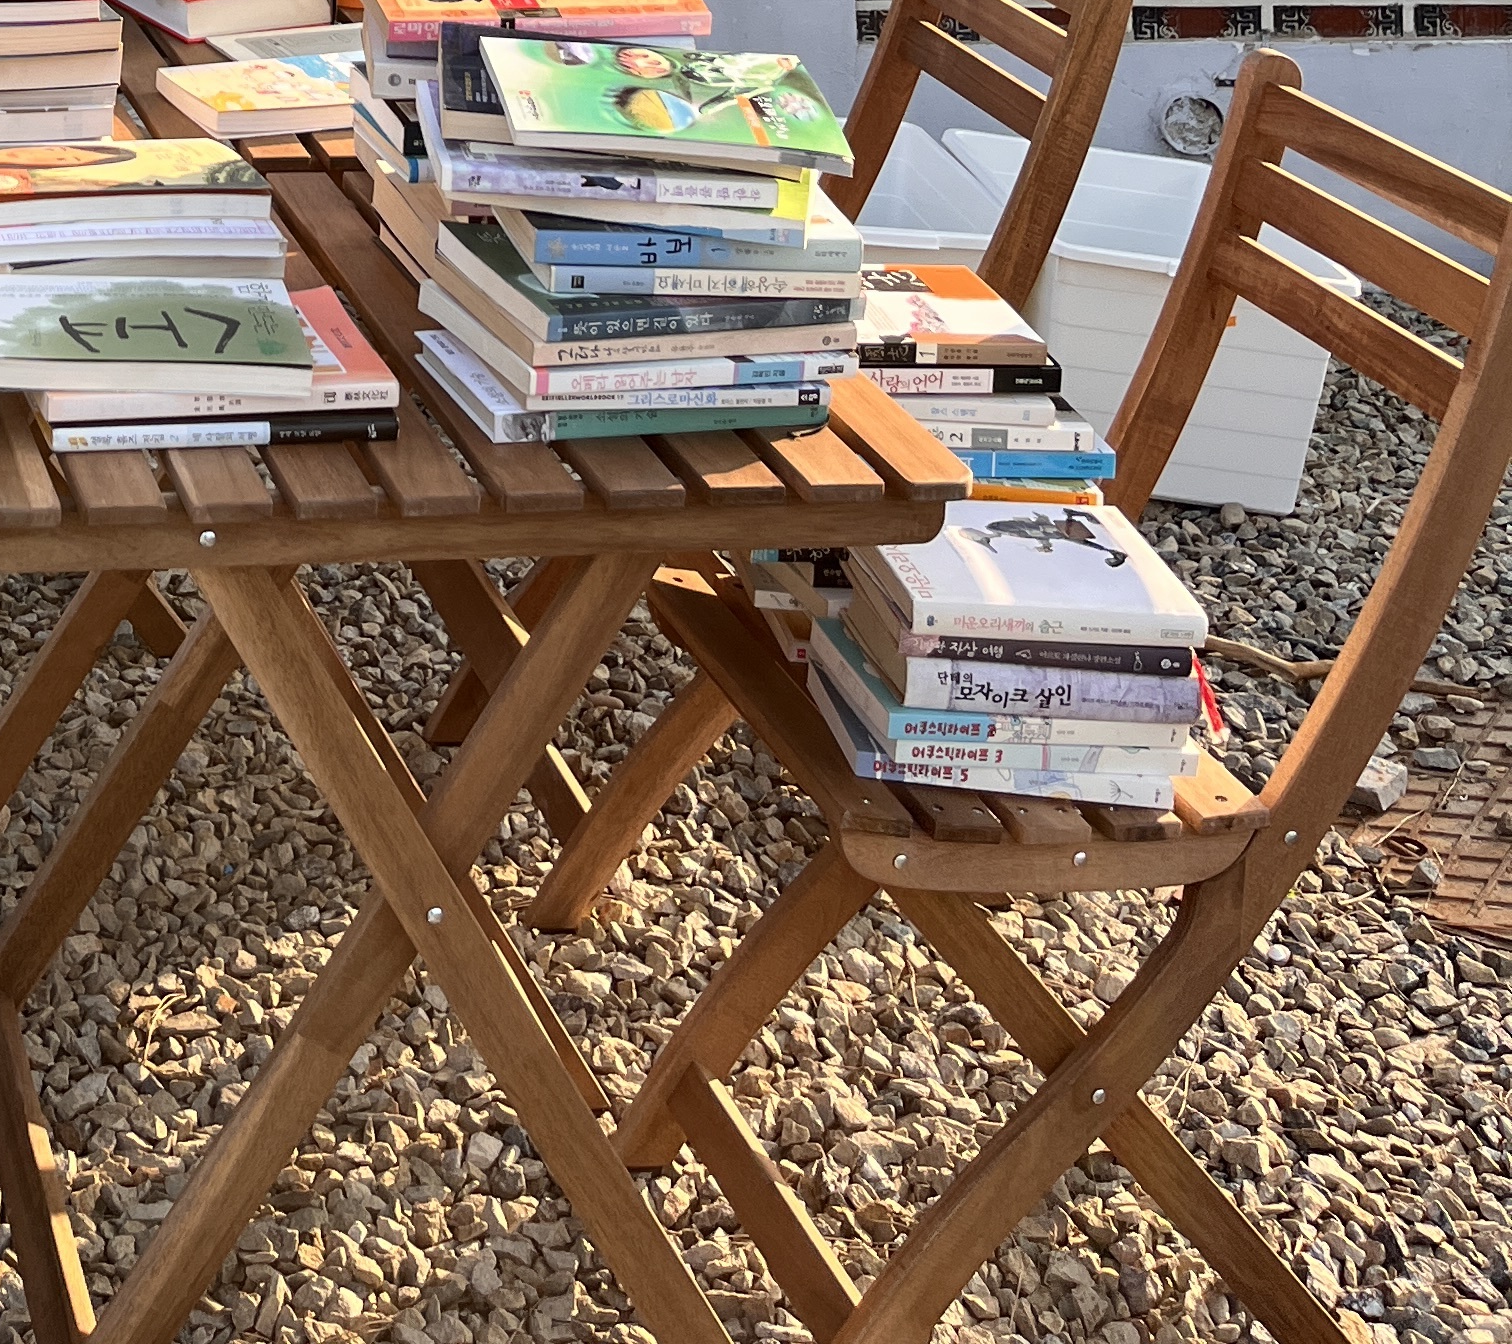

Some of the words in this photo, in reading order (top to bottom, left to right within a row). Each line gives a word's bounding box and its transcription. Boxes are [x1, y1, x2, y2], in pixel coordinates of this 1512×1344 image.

[638, 236, 692, 264] 바보
[573, 320, 603, 335] 뜻이
[606, 317, 650, 334] 있으면
[653, 315, 682, 330] 길이
[685, 311, 713, 328] 있다
[912, 370, 944, 392] 언어
[626, 391, 719, 407] 그리스로마신화
[948, 641, 979, 658] 자살
[982, 646, 1004, 660] 여행
[937, 670, 974, 686] 단테의
[954, 683, 1029, 709] 모자이크
[1035, 684, 1073, 709] 살인
[904, 720, 981, 737] 어쿠스틱라이프
[911, 745, 989, 762] 어쿠스틱라이프
[994, 748, 1004, 763] 3
[960, 768, 969, 783] 5
